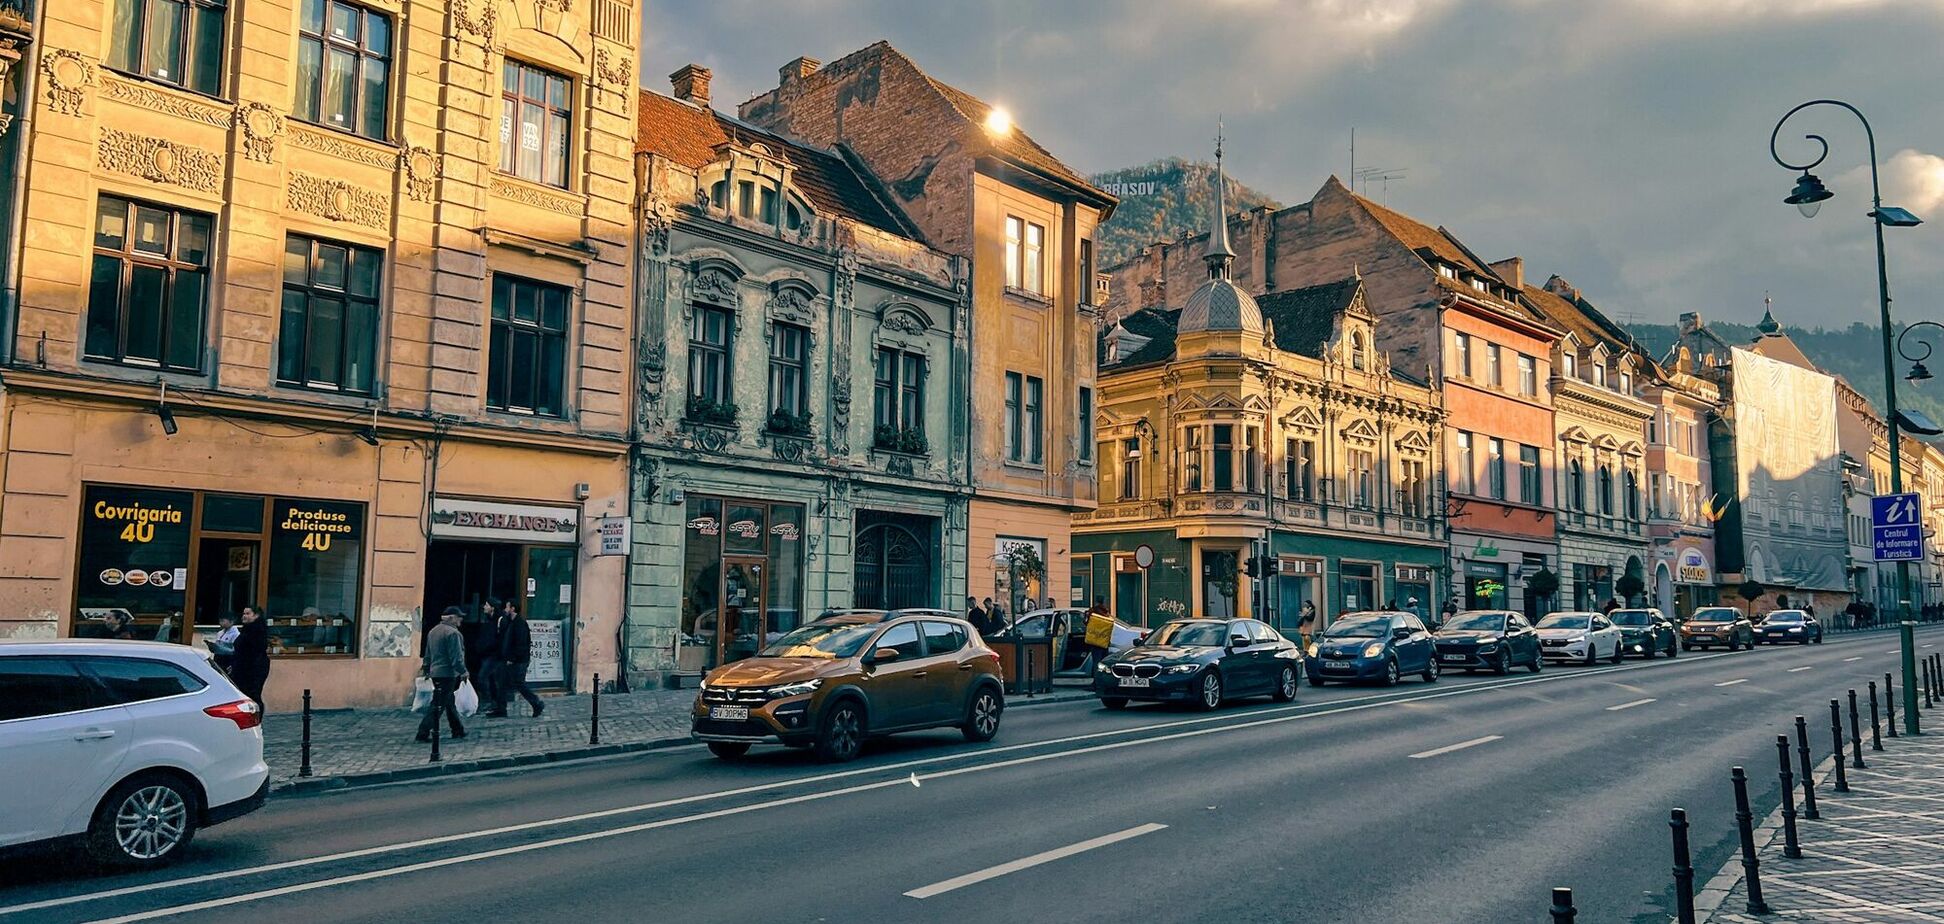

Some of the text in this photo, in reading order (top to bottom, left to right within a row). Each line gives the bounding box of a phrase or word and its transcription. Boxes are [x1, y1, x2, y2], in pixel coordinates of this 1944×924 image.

[95, 500, 182, 525] Covrigaria
[289, 508, 346, 522] Produse
[281, 518, 352, 533] delicioase
[454, 510, 558, 533] EXCHANGE
[120, 522, 155, 543] 4U
[1884, 528, 1909, 537] Centrul
[301, 532, 331, 551] 4U
[1886, 539, 1918, 548] Informare
